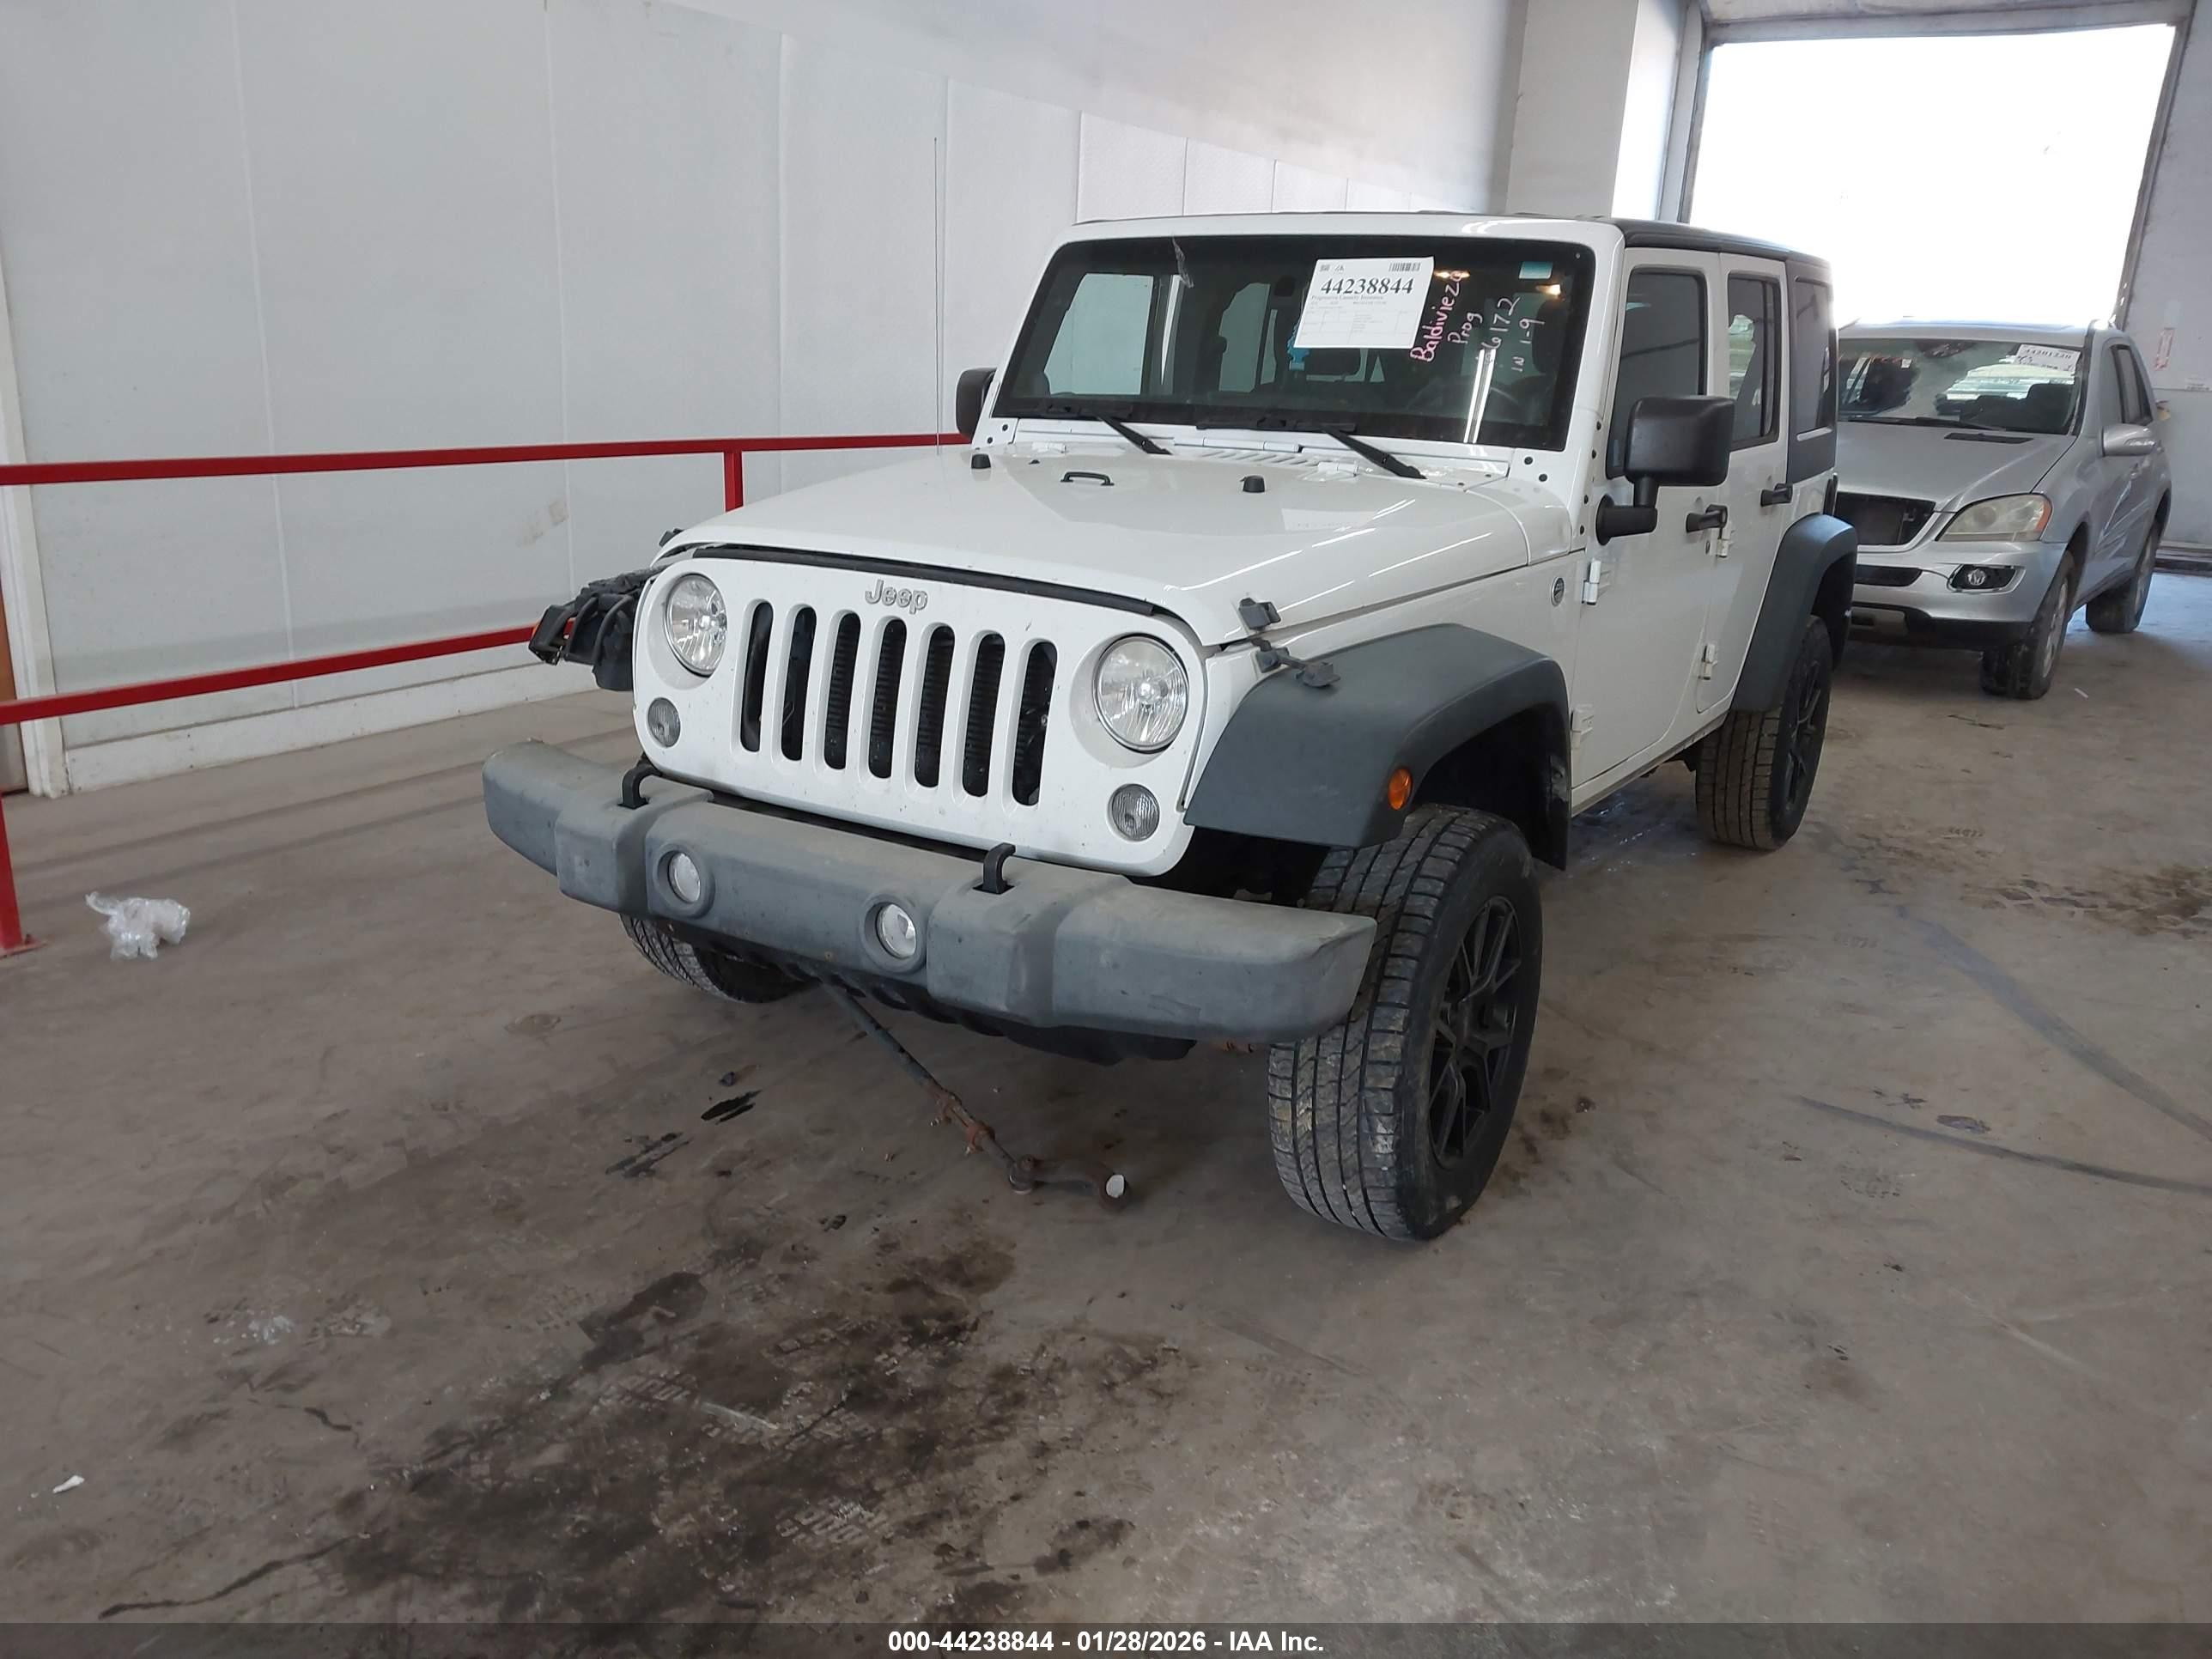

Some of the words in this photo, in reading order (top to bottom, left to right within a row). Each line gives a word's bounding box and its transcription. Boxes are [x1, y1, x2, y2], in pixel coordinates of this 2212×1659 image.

[1321, 277, 1413, 295] 44238844
[1448, 312, 1483, 343] Prog
[865, 579, 928, 615] Jeep
